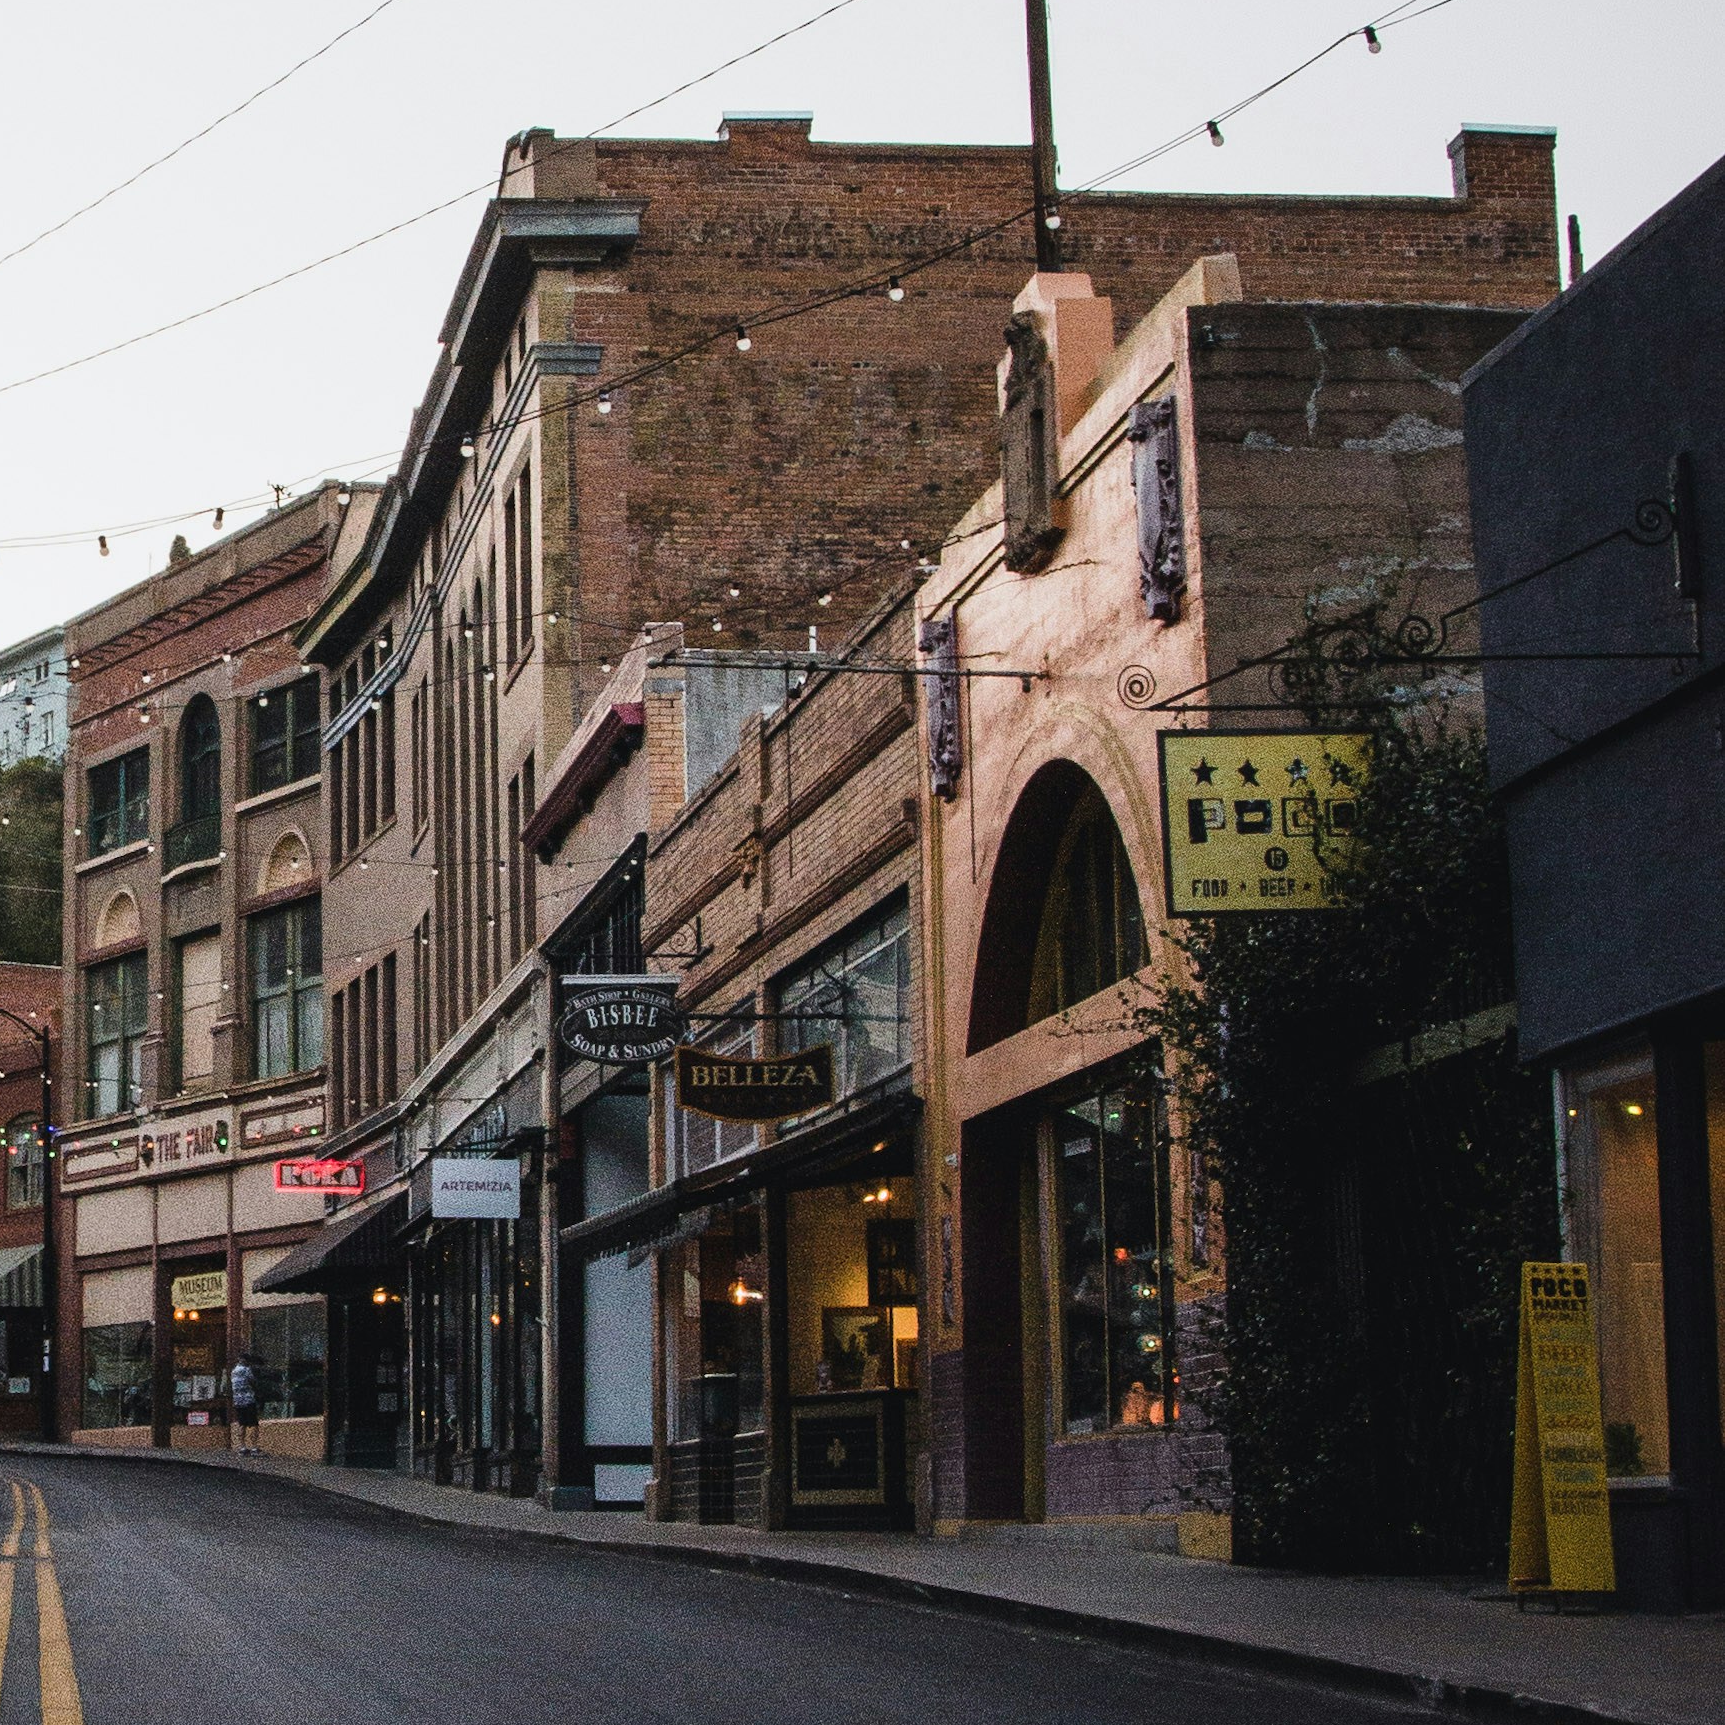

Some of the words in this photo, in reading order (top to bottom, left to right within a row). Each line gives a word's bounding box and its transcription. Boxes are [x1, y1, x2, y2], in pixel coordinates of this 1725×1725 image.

[1188, 797, 1359, 844] POCO
[1192, 879, 1228, 897] FOOD
[1259, 878, 1296, 897] BEER
[598, 990, 623, 1002] SHOP
[570, 1033, 607, 1056] SOAP
[607, 1044, 620, 1059] &
[622, 1035, 677, 1059] SUNDRY
[690, 1064, 823, 1087] BELLEZA
[156, 1132, 181, 1163] THE
[186, 1125, 214, 1159] FAIR
[441, 1181, 513, 1192] ARTEMIZIA
[178, 1275, 223, 1295] MUSEUM
[1532, 1278, 1587, 1297] POCO
[1532, 1299, 1588, 1311] MARKET
